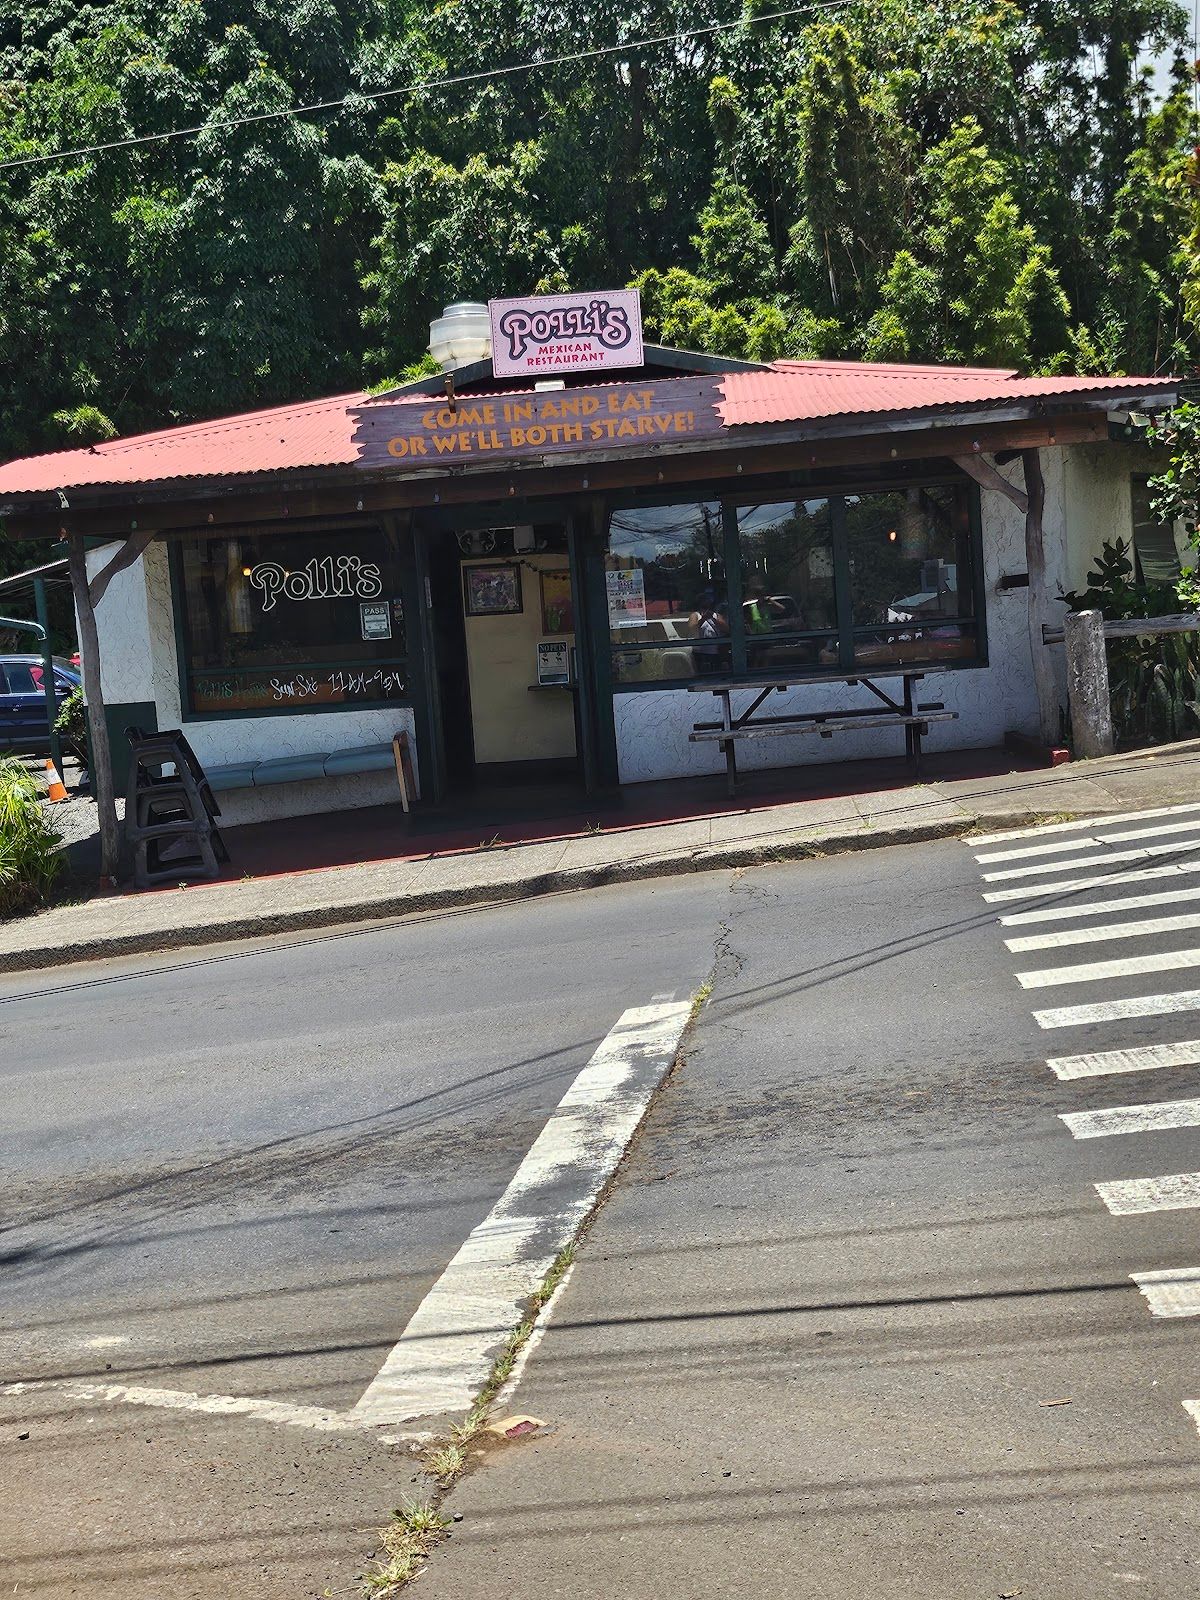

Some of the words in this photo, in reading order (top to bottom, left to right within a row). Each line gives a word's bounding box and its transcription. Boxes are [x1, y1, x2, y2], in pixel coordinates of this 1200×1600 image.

[538, 343, 592, 355] MEXICAN
[527, 352, 605, 366] RESTAURANT
[422, 404, 496, 429] COME
[504, 400, 532, 424] IN
[540, 394, 600, 419] AND
[608, 390, 655, 414] EAT
[387, 436, 428, 457] OR
[432, 429, 503, 454] WE'LL
[511, 421, 583, 446] BOTH
[590, 411, 694, 440] STARVE!
[249, 556, 382, 612] Polli's
[364, 607, 385, 615] PASS
[539, 644, 550, 653] NO
